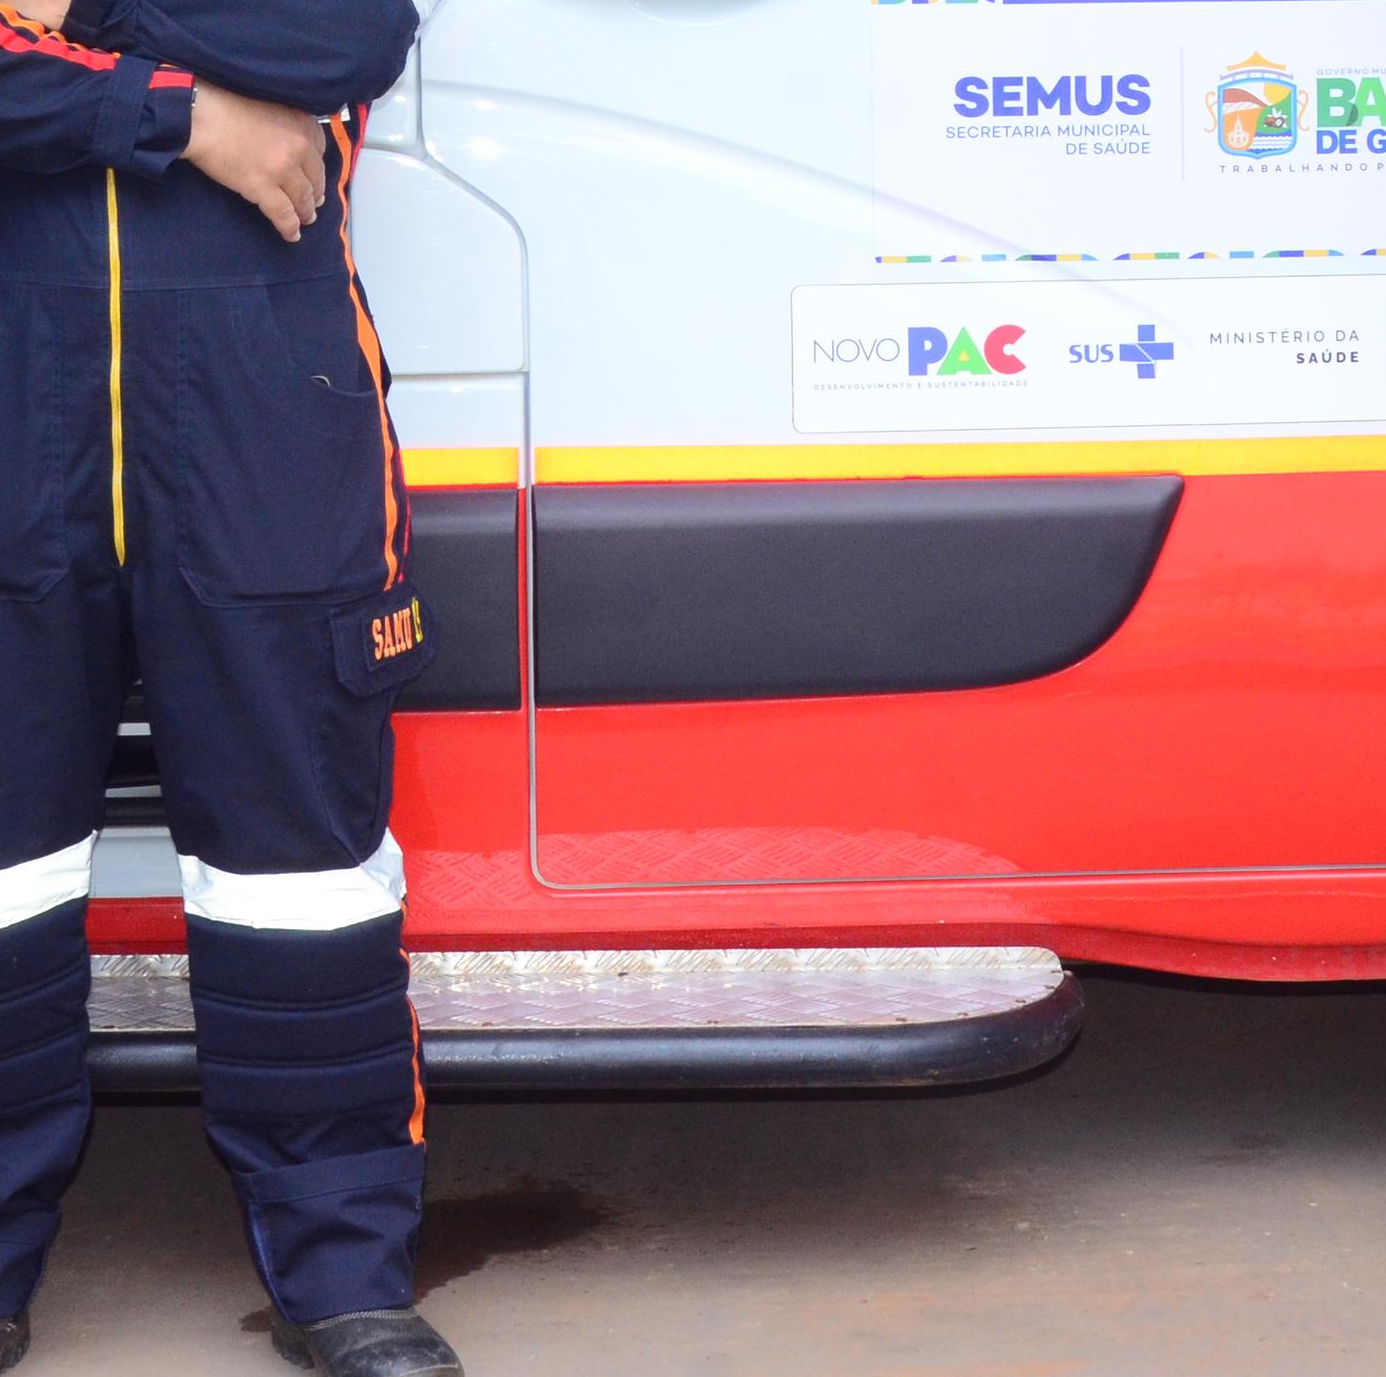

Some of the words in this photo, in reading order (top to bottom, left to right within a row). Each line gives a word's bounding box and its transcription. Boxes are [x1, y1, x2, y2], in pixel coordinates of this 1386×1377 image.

[1316, 68, 1369, 76] GOVERNO
[953, 73, 1152, 119] SEMUS
[945, 124, 1052, 139] SECRETARIA
[1057, 123, 1152, 138] MUNICIPAL
[1065, 141, 1088, 156] DE
[1093, 138, 1152, 155] SAÚDE
[1316, 129, 1357, 154] DE
[1219, 162, 1369, 173] TRABALHANDO
[1210, 328, 1326, 345] MINISTÉRIO
[1335, 328, 1361, 343] DA
[813, 338, 900, 364] NOVO
[908, 324, 1027, 376] PAC
[1069, 343, 1115, 365] SUS
[1296, 348, 1361, 365] SAÚDE
[813, 383, 913, 391] DESENVOLVIMENTO
[927, 380, 1029, 389] SUSTENTABILIDADE
[372, 607, 413, 661] SAMU
